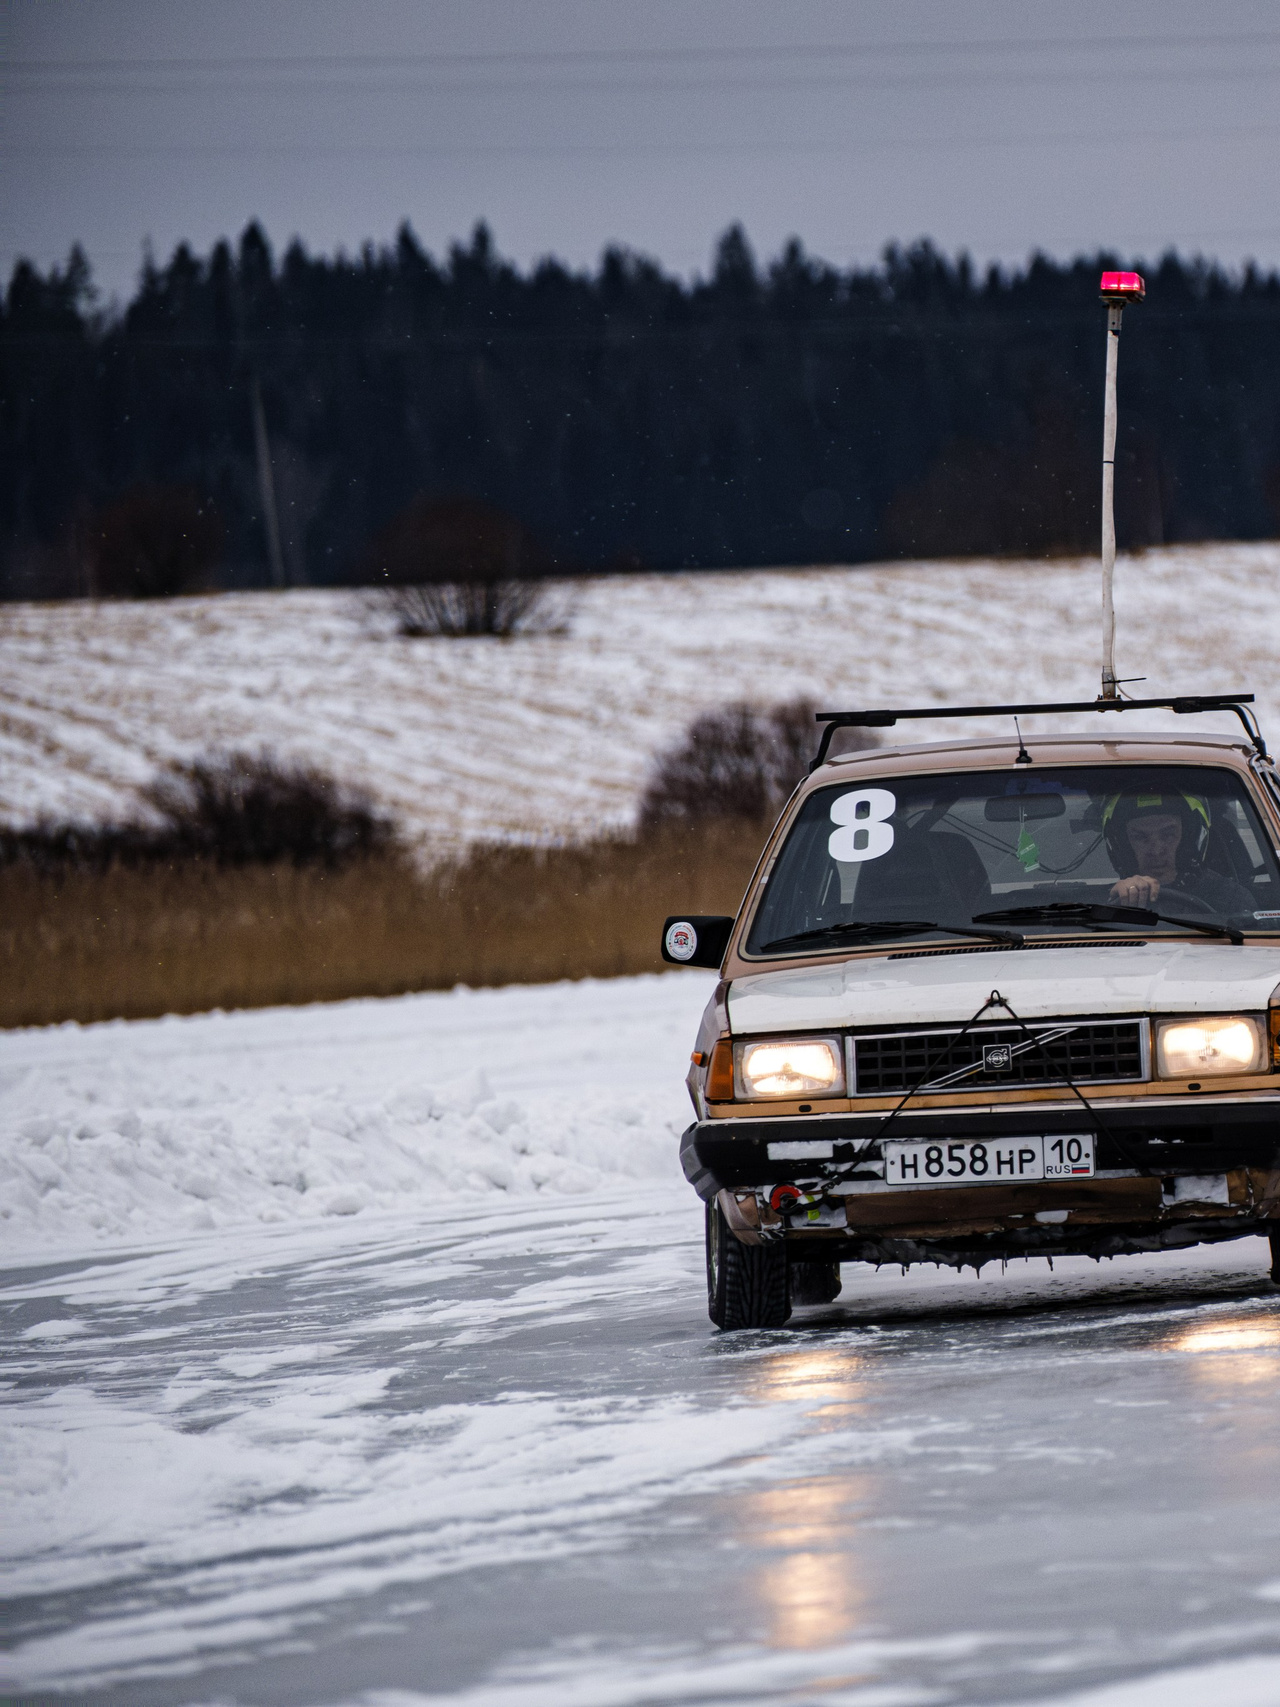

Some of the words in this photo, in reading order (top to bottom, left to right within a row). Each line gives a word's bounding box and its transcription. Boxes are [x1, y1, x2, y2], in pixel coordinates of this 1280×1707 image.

[828, 789, 896, 862] 8
[1050, 1138, 1082, 1163] 10
[1046, 1164, 1071, 1175] RUS
